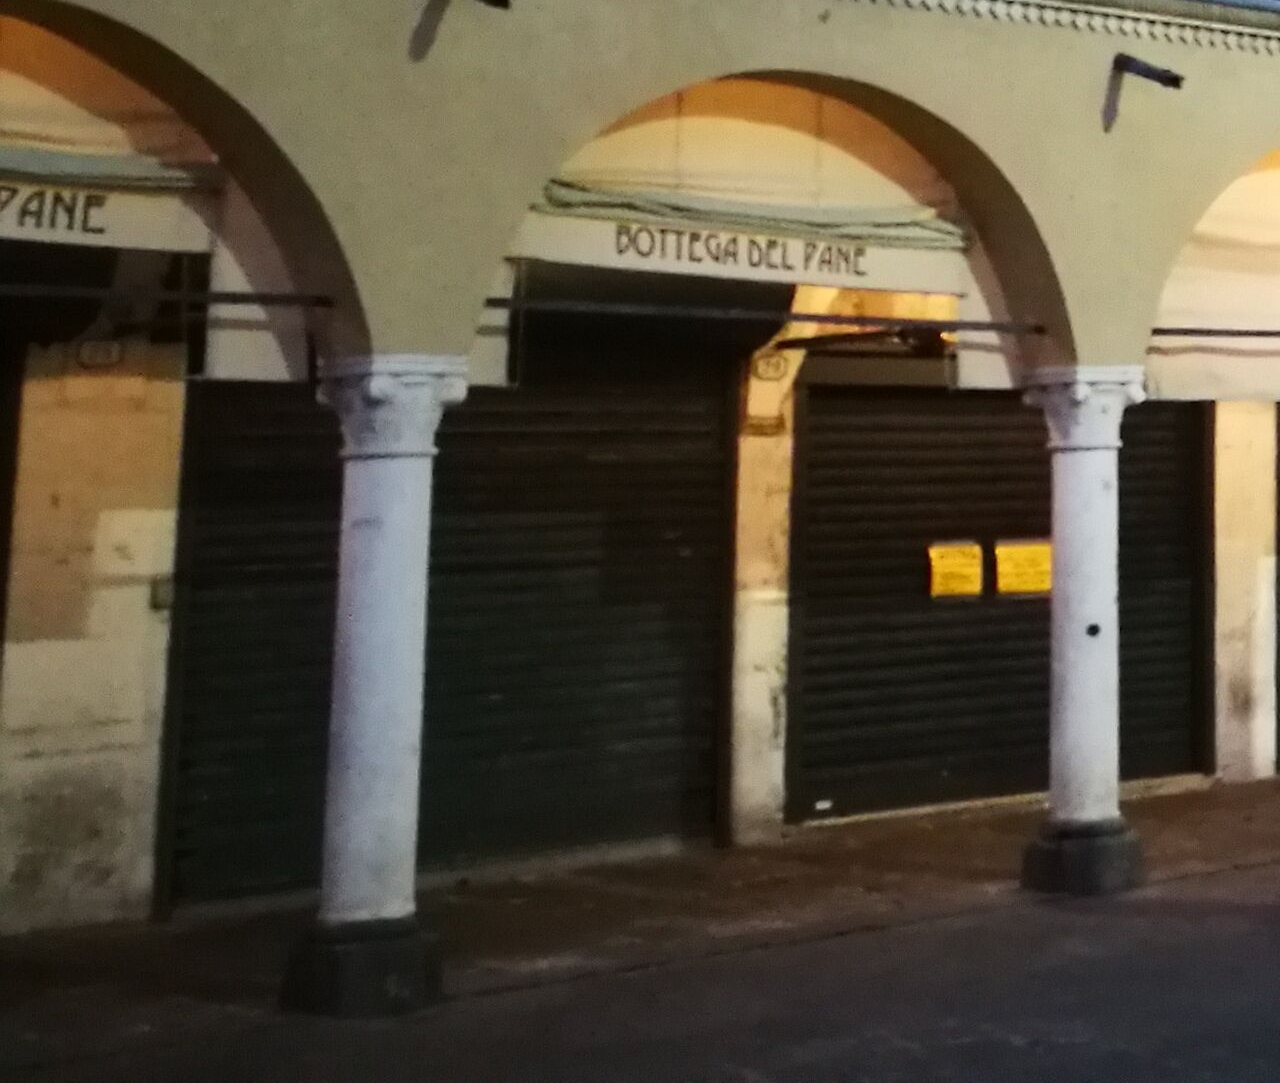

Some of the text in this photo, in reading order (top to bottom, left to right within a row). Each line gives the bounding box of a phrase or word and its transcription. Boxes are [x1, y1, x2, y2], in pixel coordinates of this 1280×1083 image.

[615, 225, 868, 277] BOTTEGA DEL PANE
